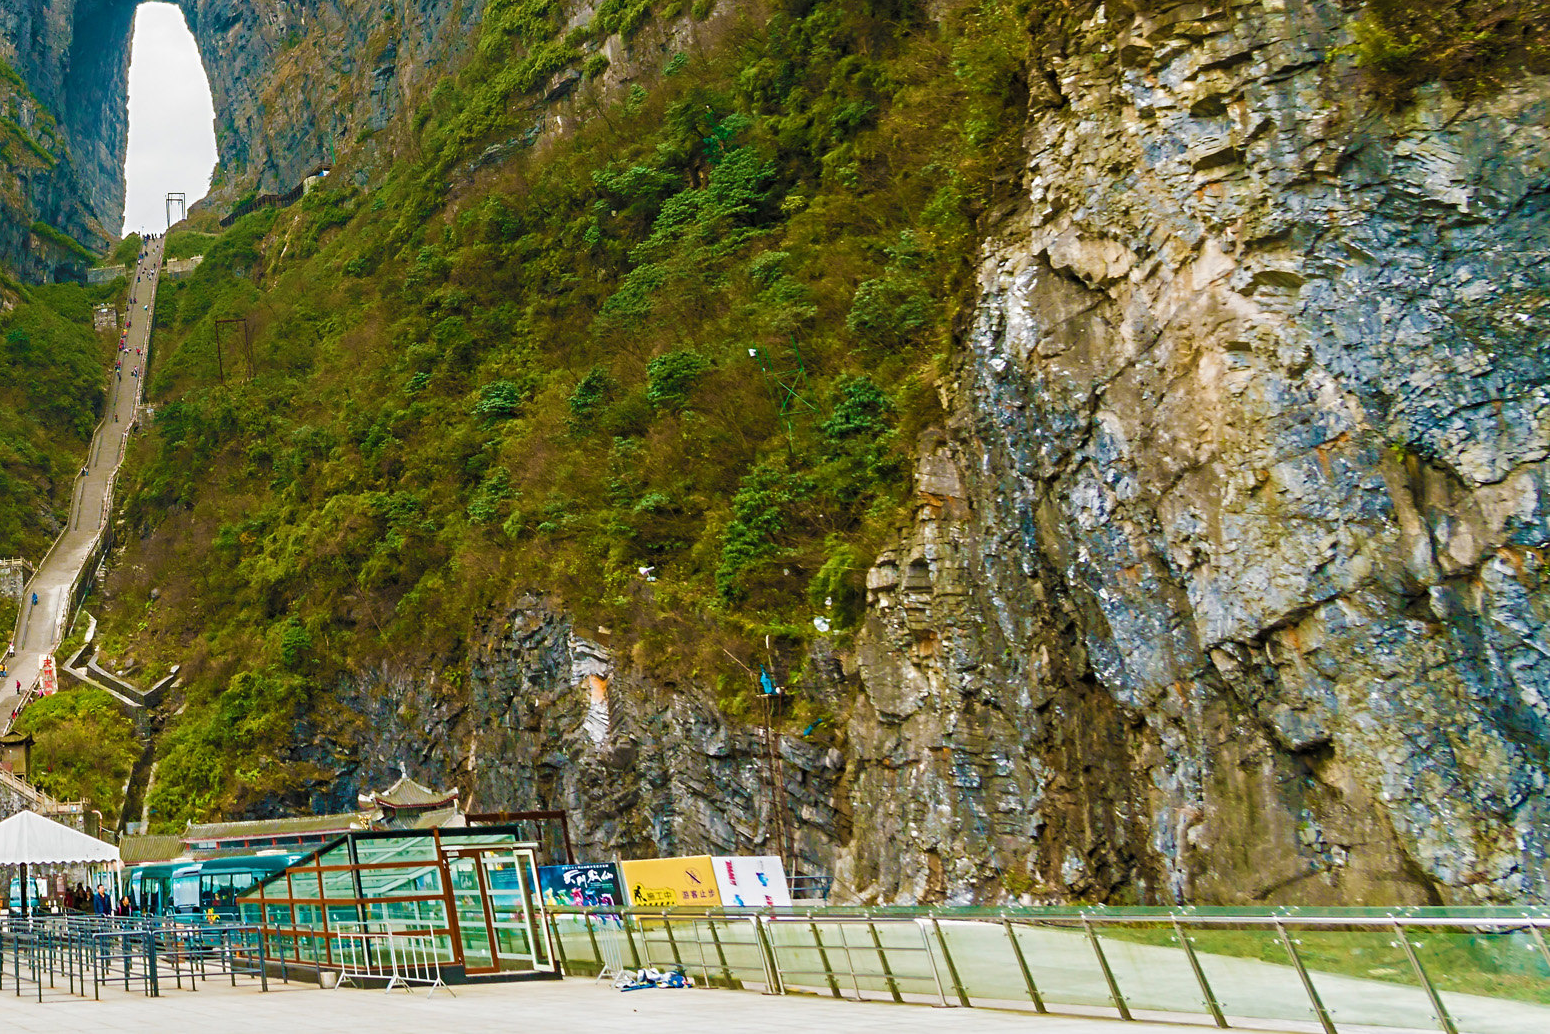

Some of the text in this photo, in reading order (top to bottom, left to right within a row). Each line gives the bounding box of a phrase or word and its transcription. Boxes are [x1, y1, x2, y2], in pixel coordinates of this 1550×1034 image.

[647, 891, 673, 902] 施工中
[682, 888, 716, 900] 游客止步
